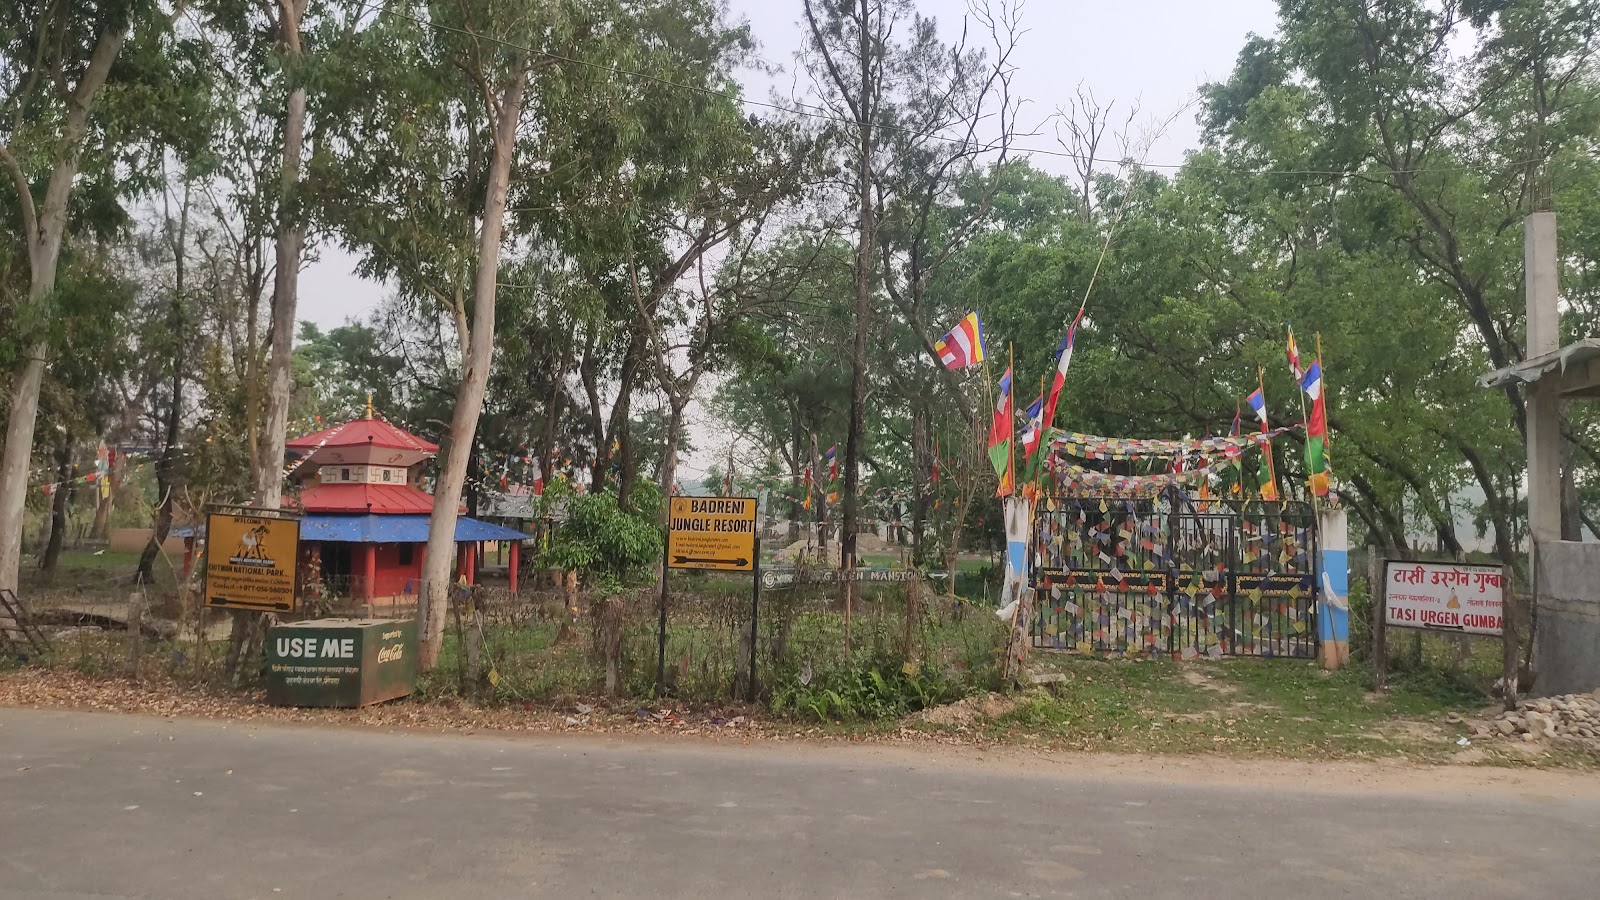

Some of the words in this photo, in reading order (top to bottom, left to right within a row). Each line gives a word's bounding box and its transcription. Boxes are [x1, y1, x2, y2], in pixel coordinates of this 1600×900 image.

[691, 500, 745, 514] BADRENI
[234, 517, 261, 525] WELCOME
[670, 517, 711, 532] JUNGLE
[713, 519, 754, 533] RESORT
[208, 564, 233, 572] CHITWAN
[233, 566, 265, 576] NATIONAL
[822, 571, 864, 582] GEEN
[1393, 565, 1427, 585] टासी
[1430, 567, 1470, 588] उरगेन
[1473, 573, 1503, 593] गुम्बा
[1389, 607, 1416, 621] TASI
[1420, 610, 1459, 625] URGEN
[1463, 613, 1503, 629] GUMBA
[276, 637, 317, 658] USE
[321, 638, 354, 658] ME
